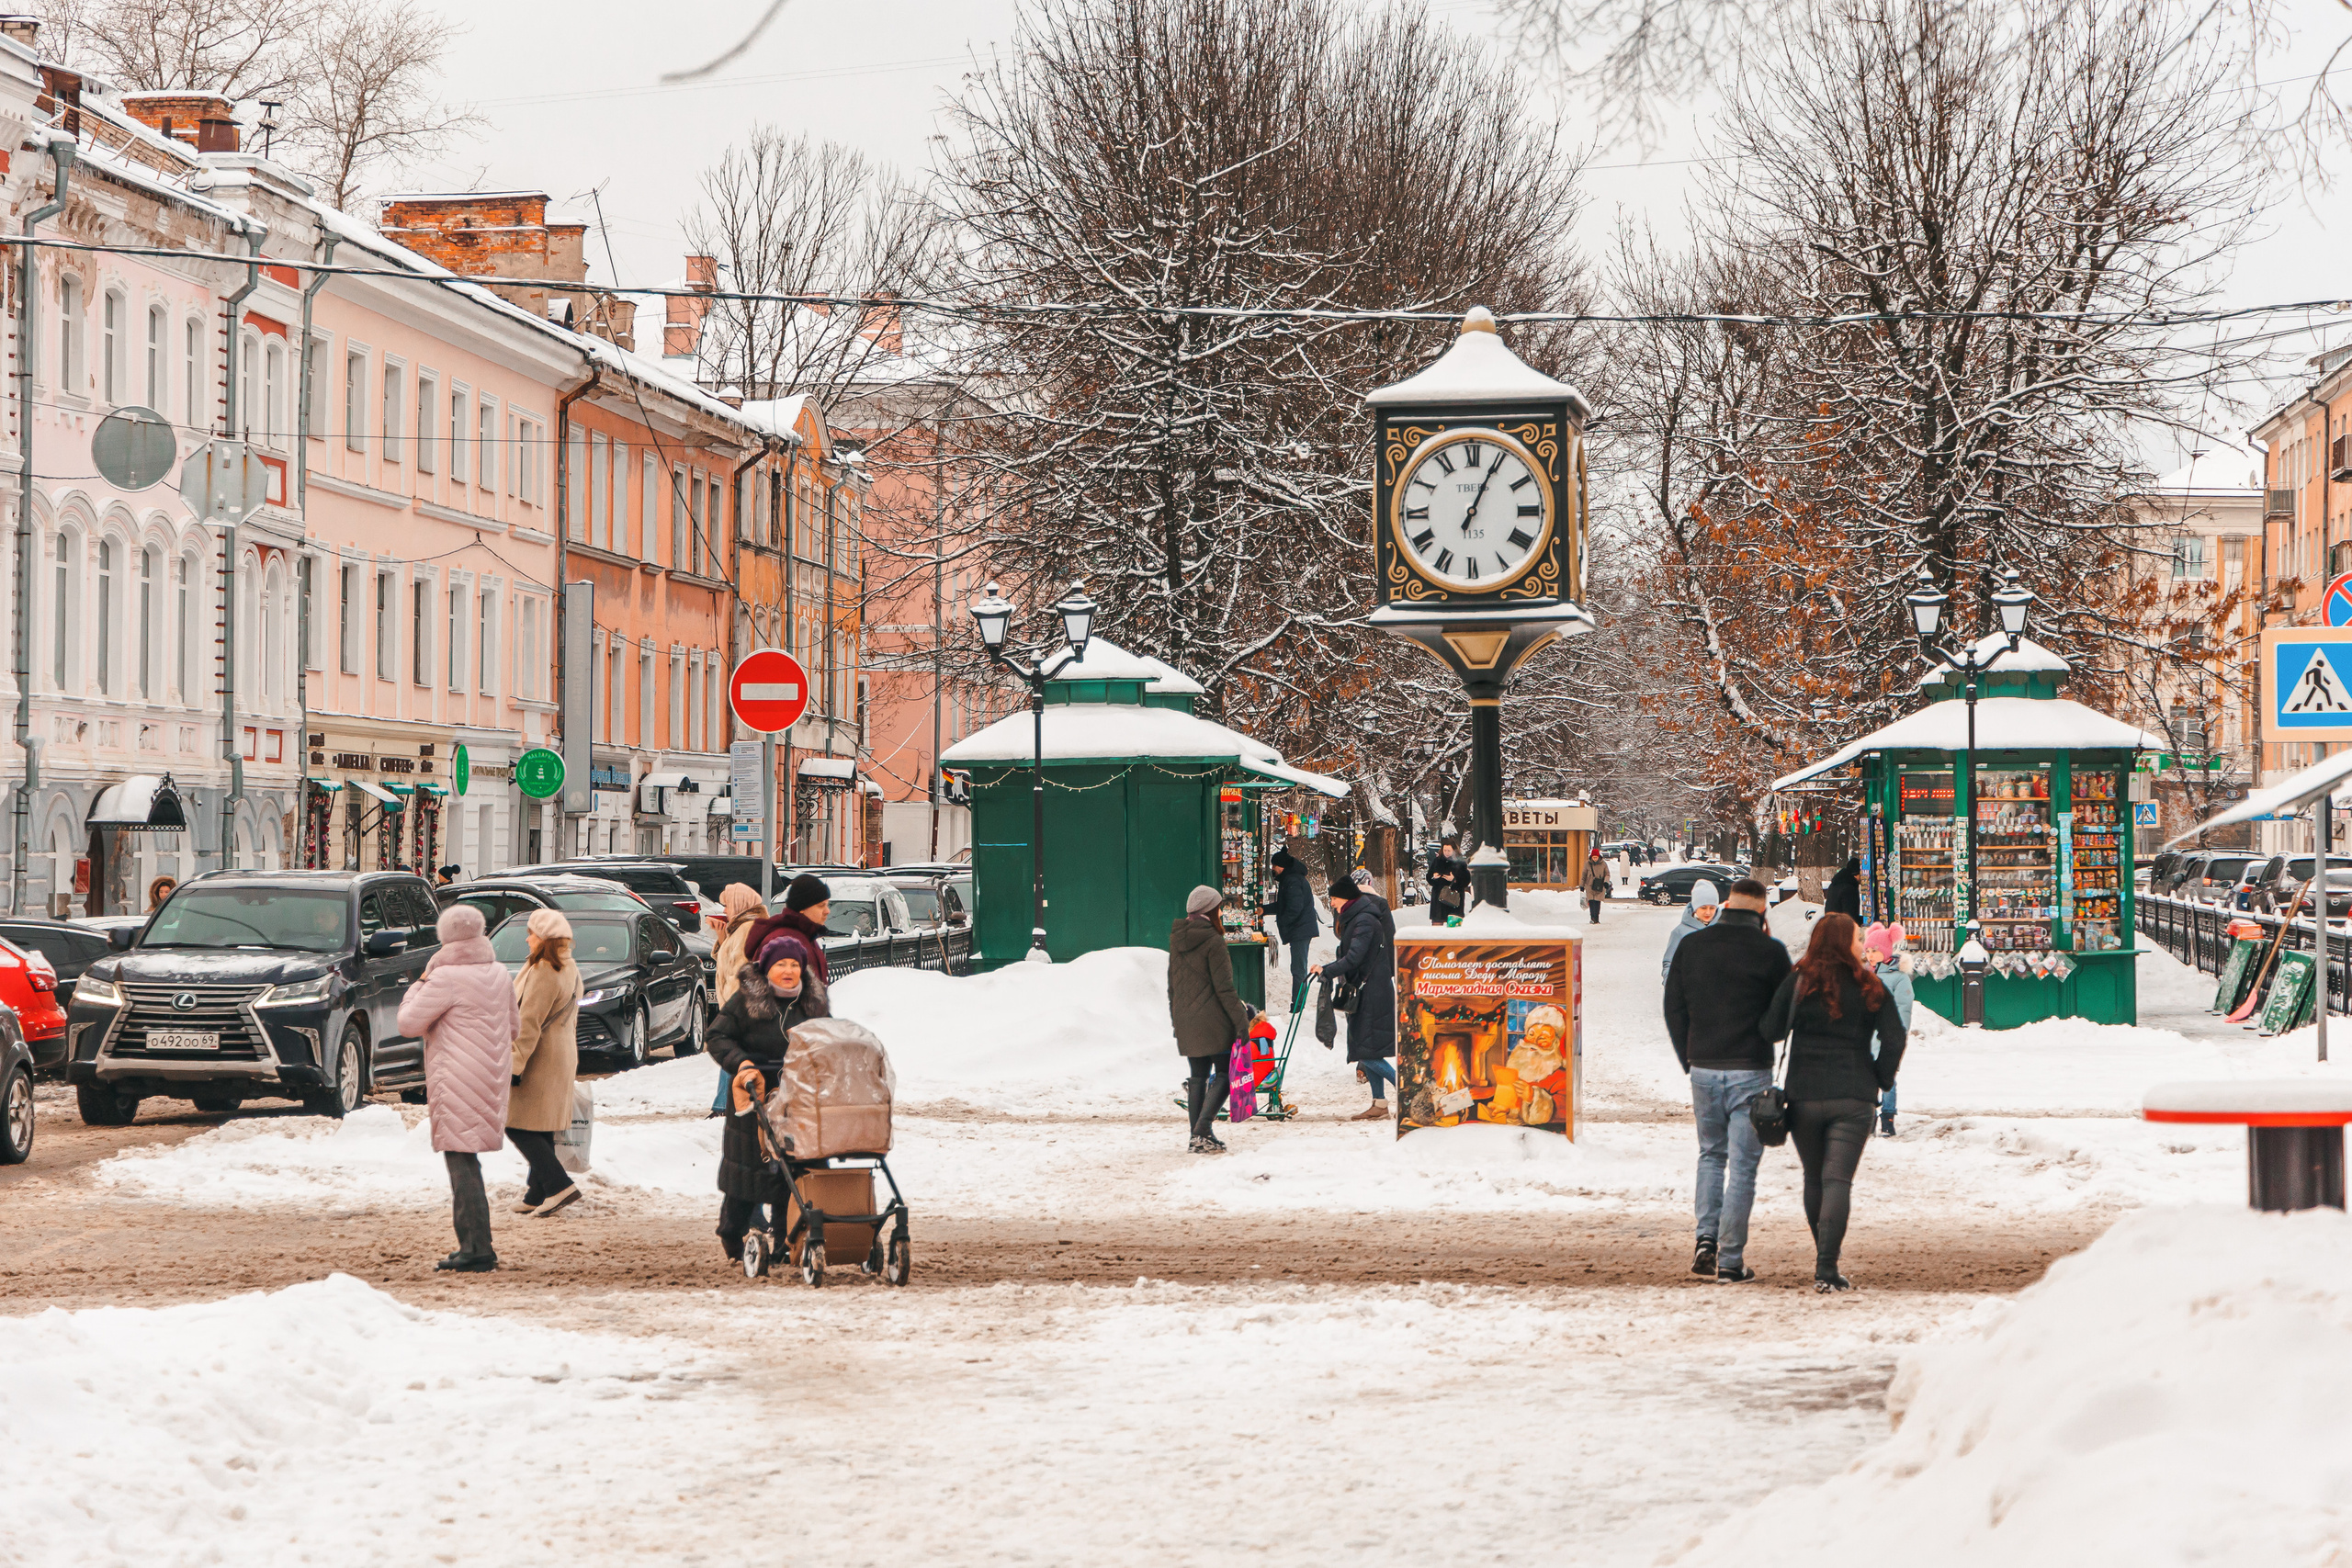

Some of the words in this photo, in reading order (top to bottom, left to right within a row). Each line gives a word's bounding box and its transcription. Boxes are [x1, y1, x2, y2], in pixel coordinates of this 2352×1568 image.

[1433, 450, 1457, 478] XI
[1463, 445, 1482, 468] XII
[1412, 473, 1438, 496] X
[1463, 529, 1485, 539] 1135
[1418, 956, 1484, 970] Помогает
[1485, 956, 1553, 972] доставлять
[1422, 972, 1463, 980] письма
[1464, 968, 1497, 983] Деду
[1498, 967, 1548, 983] Морозу
[1416, 981, 1503, 997] Мармеладная
[1505, 980, 1554, 996] Сказка
[201, 1035, 214, 1044] 69
